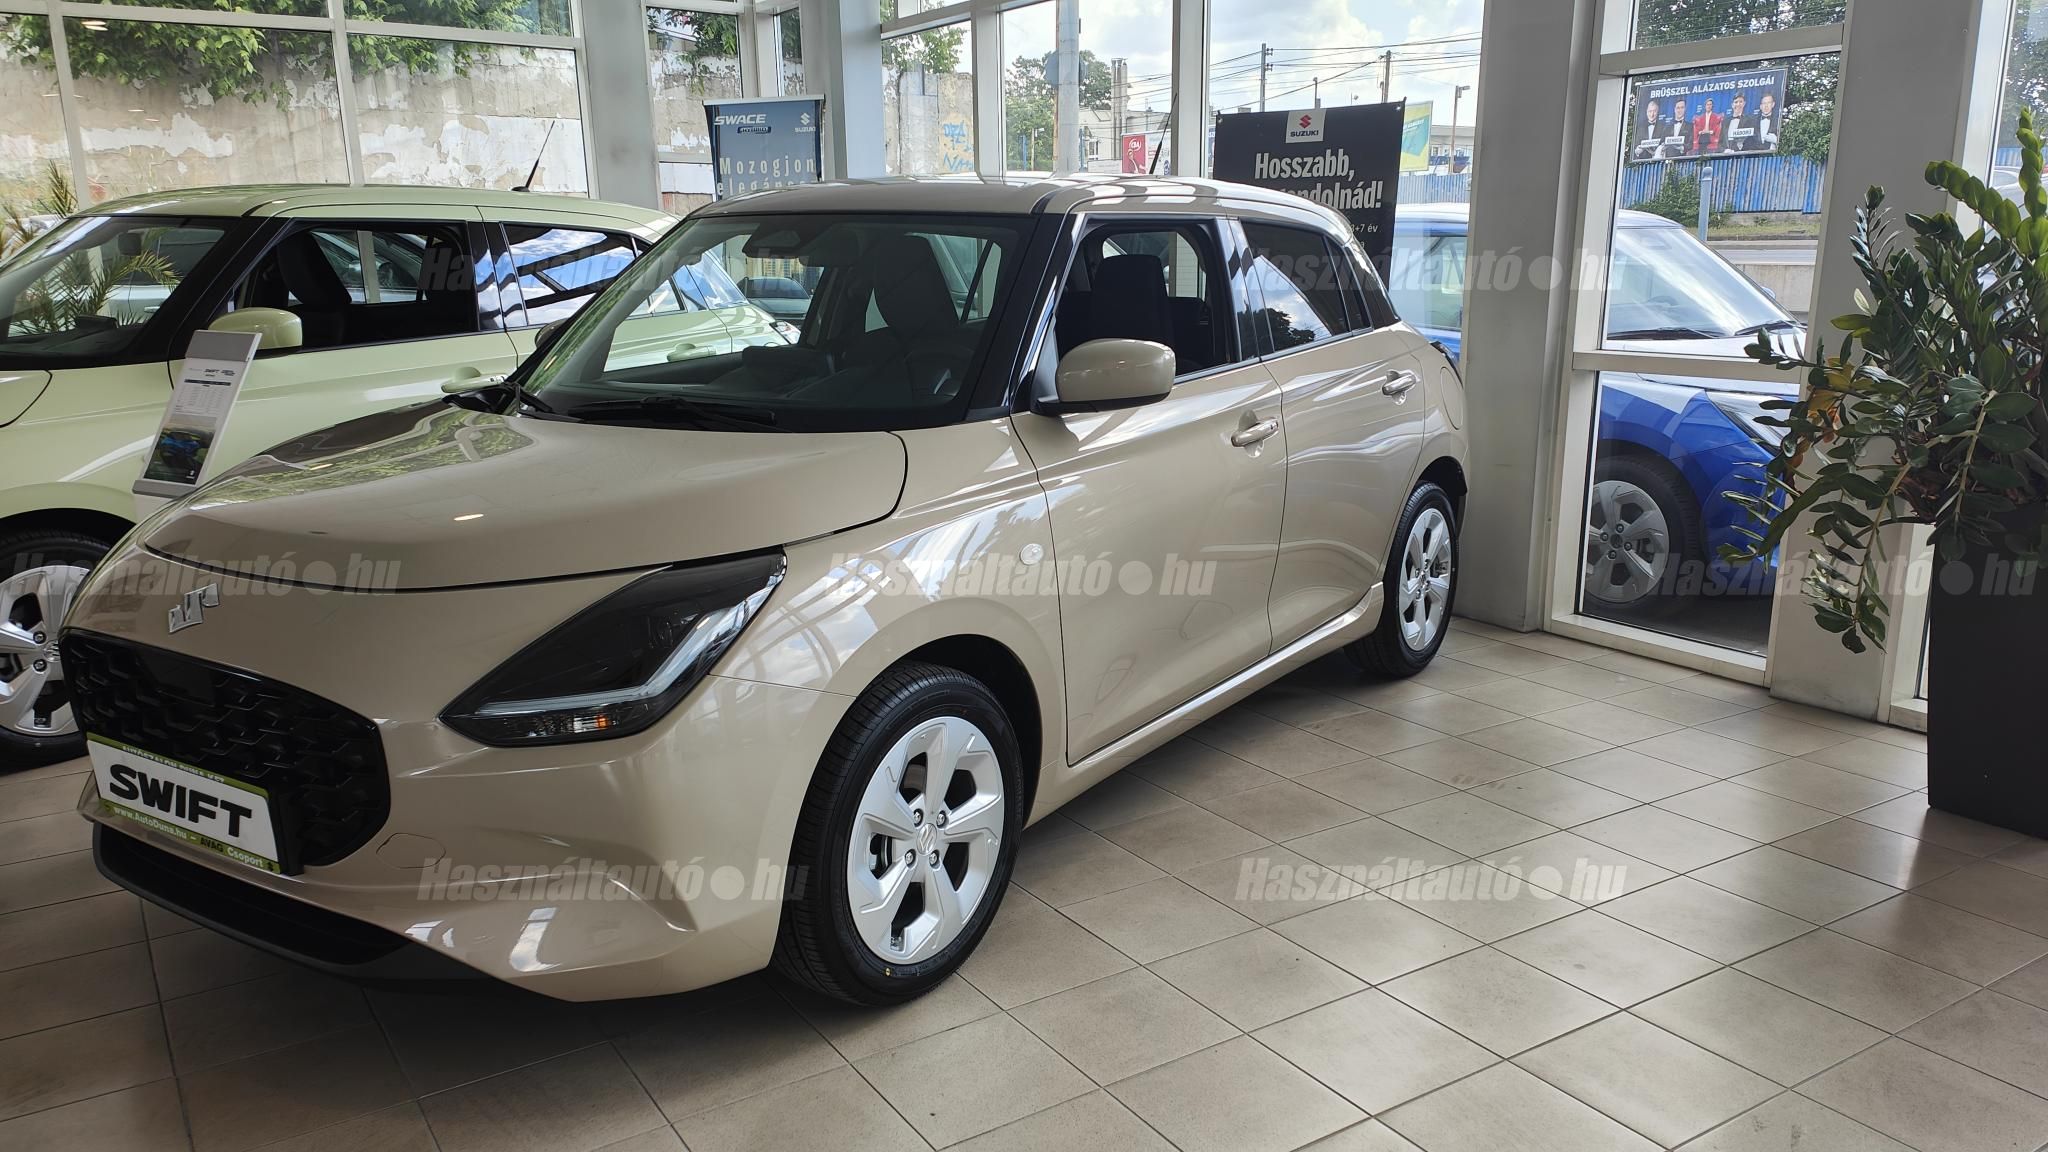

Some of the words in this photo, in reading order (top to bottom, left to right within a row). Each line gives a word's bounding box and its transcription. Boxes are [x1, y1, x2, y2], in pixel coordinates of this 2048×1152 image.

[1692, 80, 1735, 93] ALÁZATOS
[1737, 76, 1775, 88] SZOLGÁI
[714, 114, 766, 125] SWACE
[1290, 129, 1319, 137] SUZUKI
[719, 155, 816, 177] Mozogjon
[1254, 149, 1355, 181] Hosszabb,
[109, 763, 252, 837] SWIFT
[227, 847, 264, 868] Csoport
